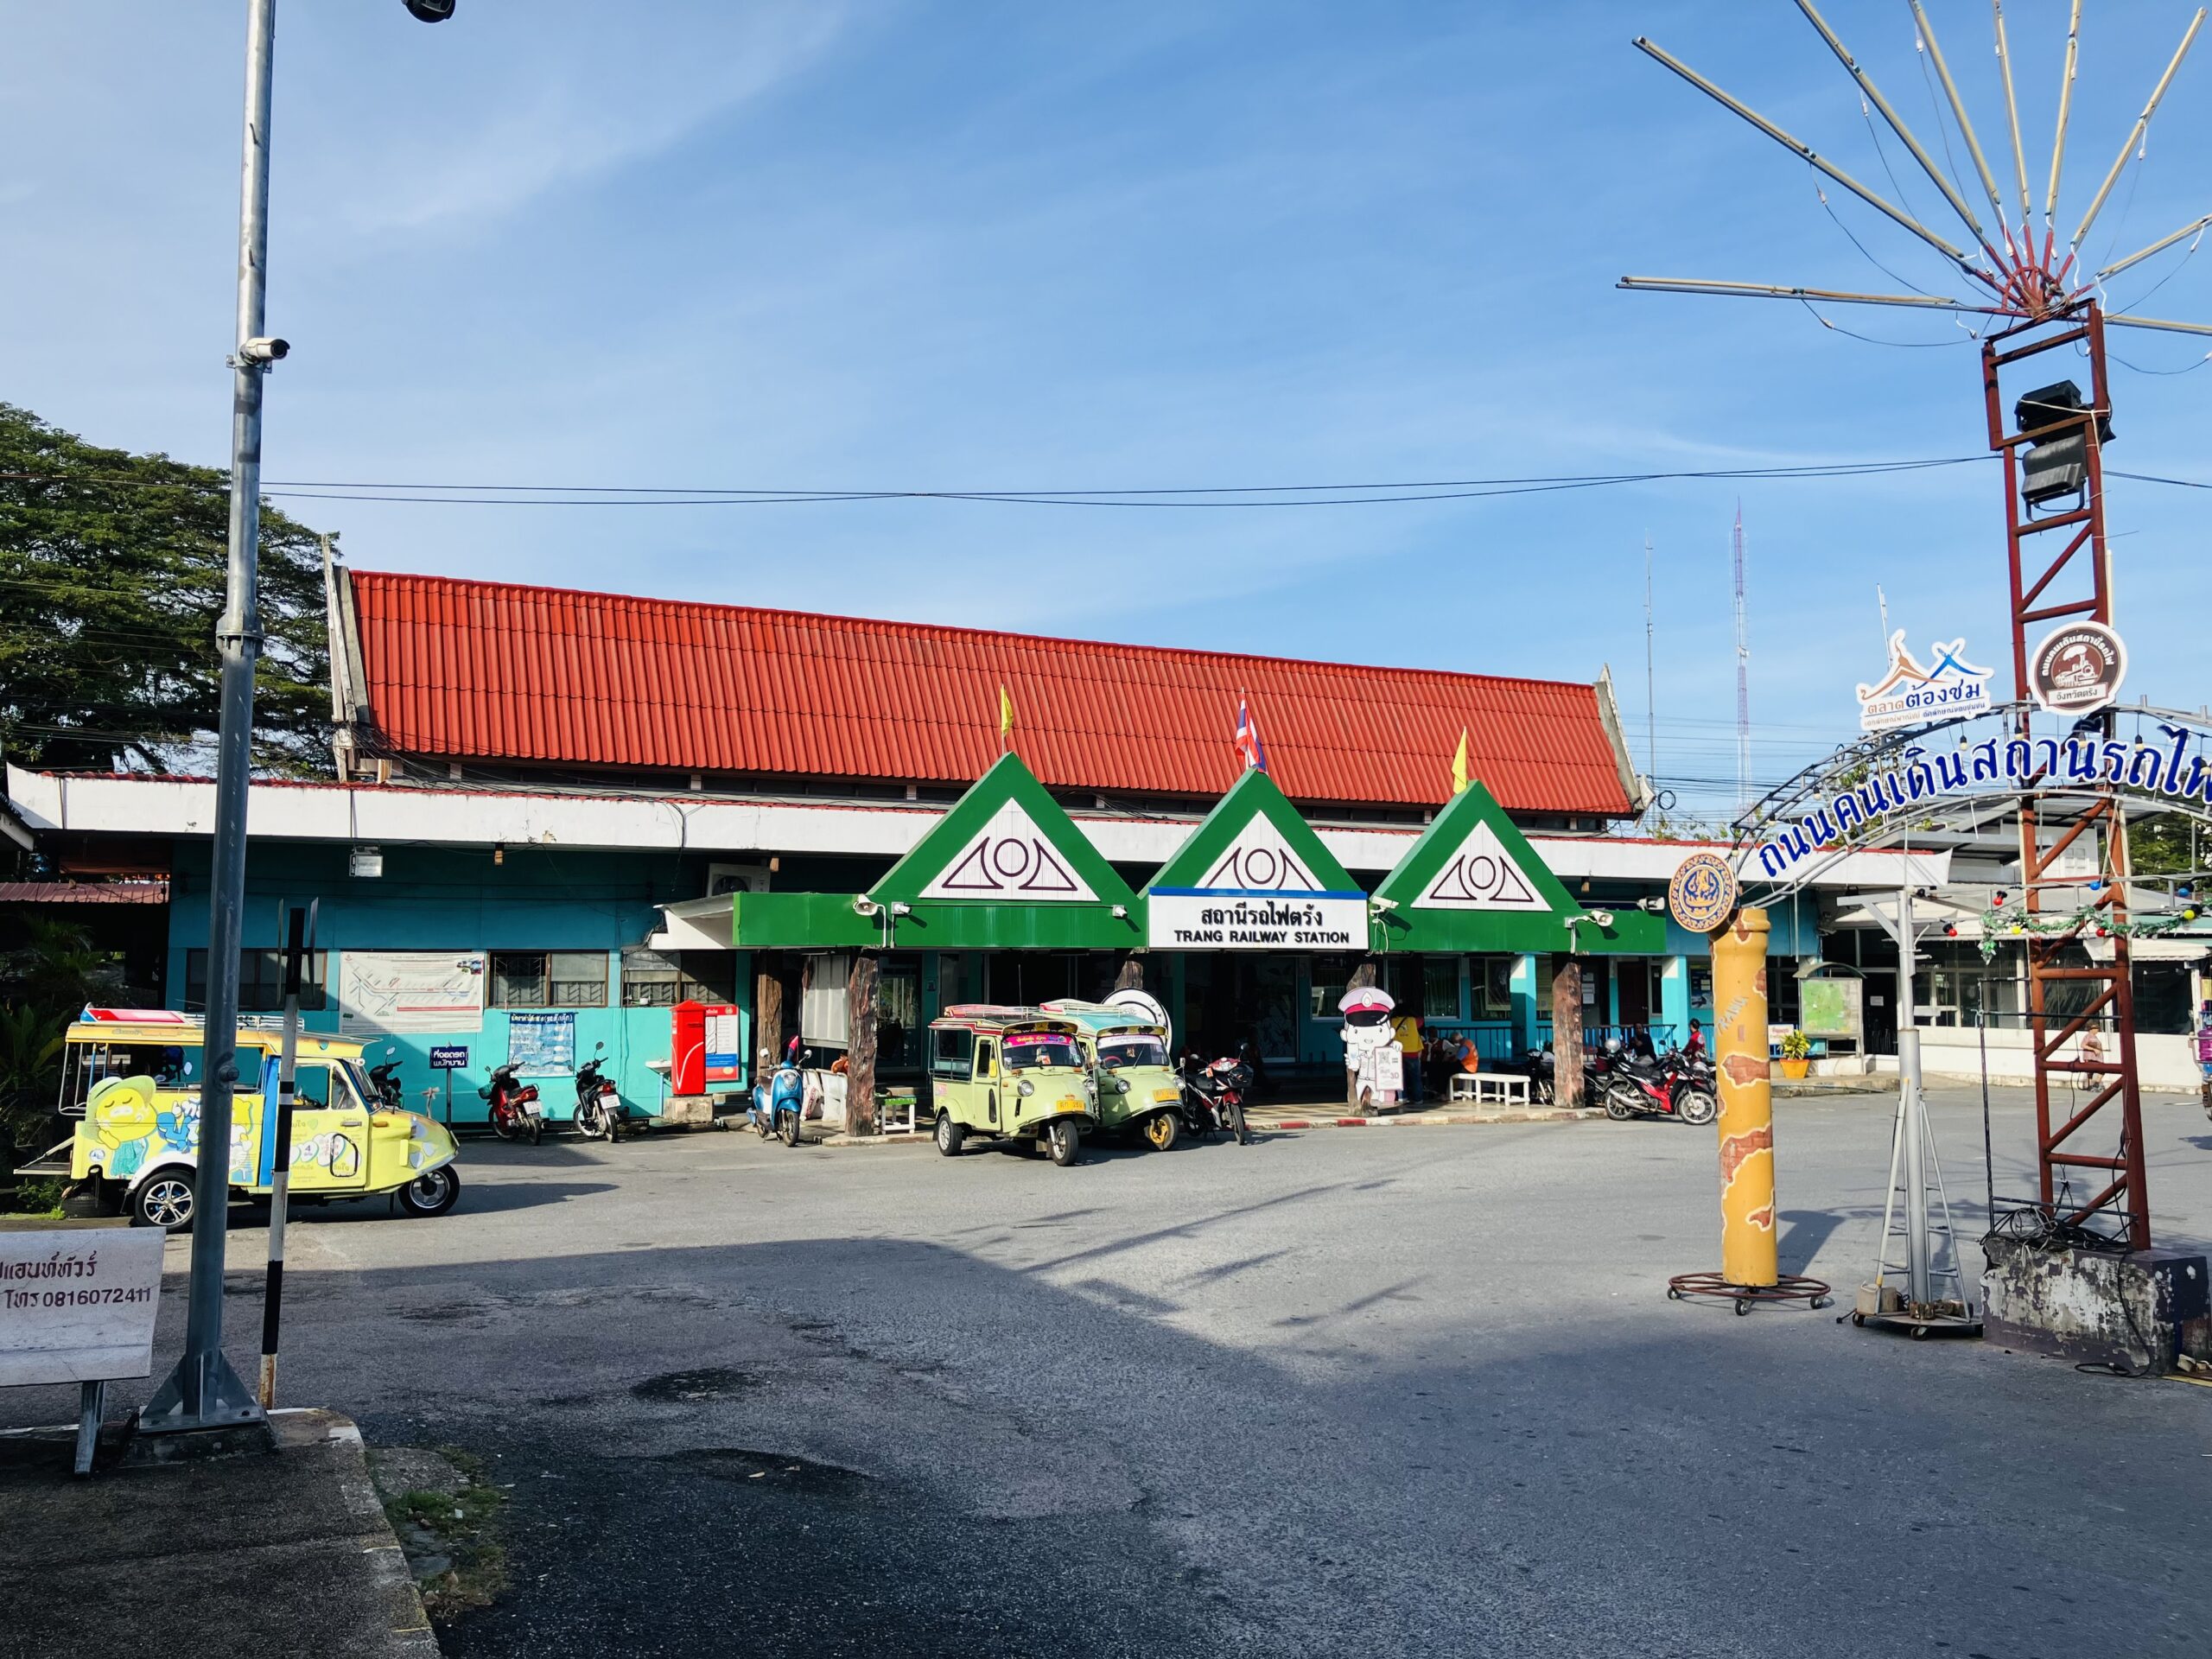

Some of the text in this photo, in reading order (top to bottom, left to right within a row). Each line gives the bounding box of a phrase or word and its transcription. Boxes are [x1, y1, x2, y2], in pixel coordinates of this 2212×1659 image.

[2056, 687, 2098, 701] จังหวัดตรัง
[1201, 900, 1323, 926] สถานีรถไฟตรัง
[1174, 930, 1350, 944] TRANG RAILWAY STATION
[433, 1048, 466, 1058] ที่จอดรถ
[5, 1287, 151, 1309] โทร 0816072411
